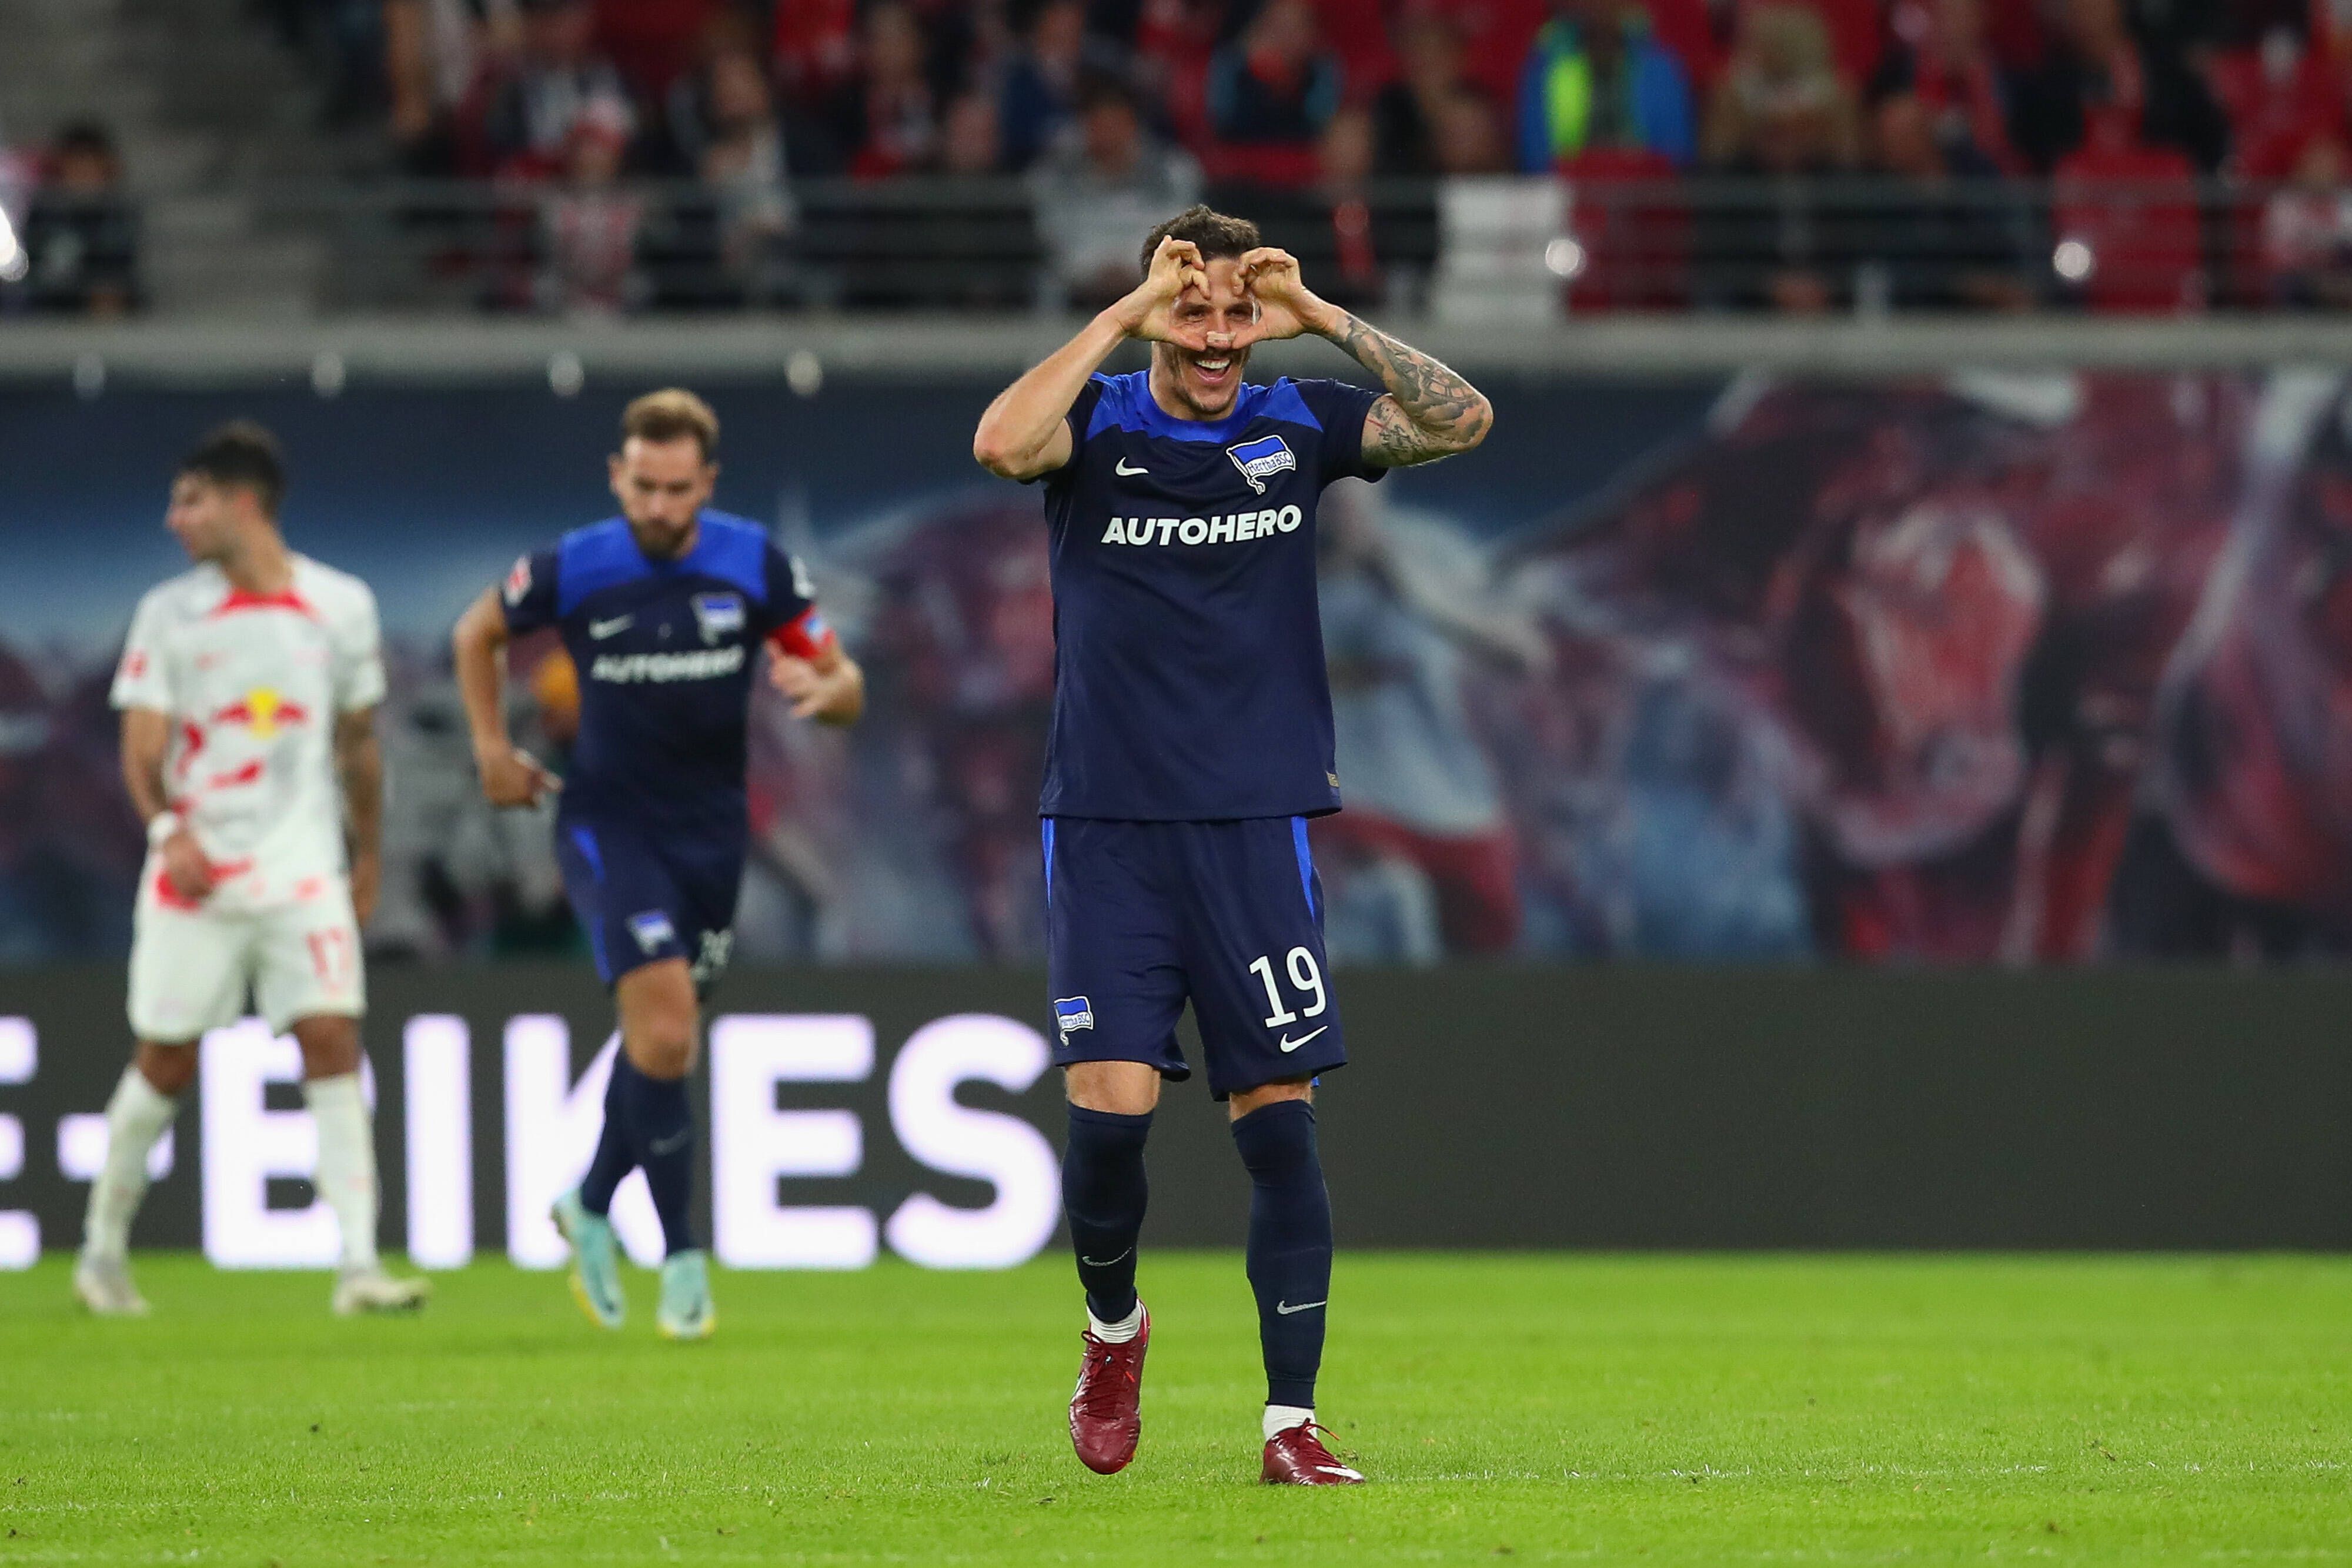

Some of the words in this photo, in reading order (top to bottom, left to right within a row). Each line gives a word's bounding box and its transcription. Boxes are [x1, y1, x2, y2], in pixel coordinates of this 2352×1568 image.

[1247, 459, 1277, 473] Hertha
[1274, 452, 1292, 464] BSC
[1101, 504, 1302, 546] AUTOHERO
[1249, 945, 1327, 1028] 19
[0, 1014, 1060, 1271] -BIKES
